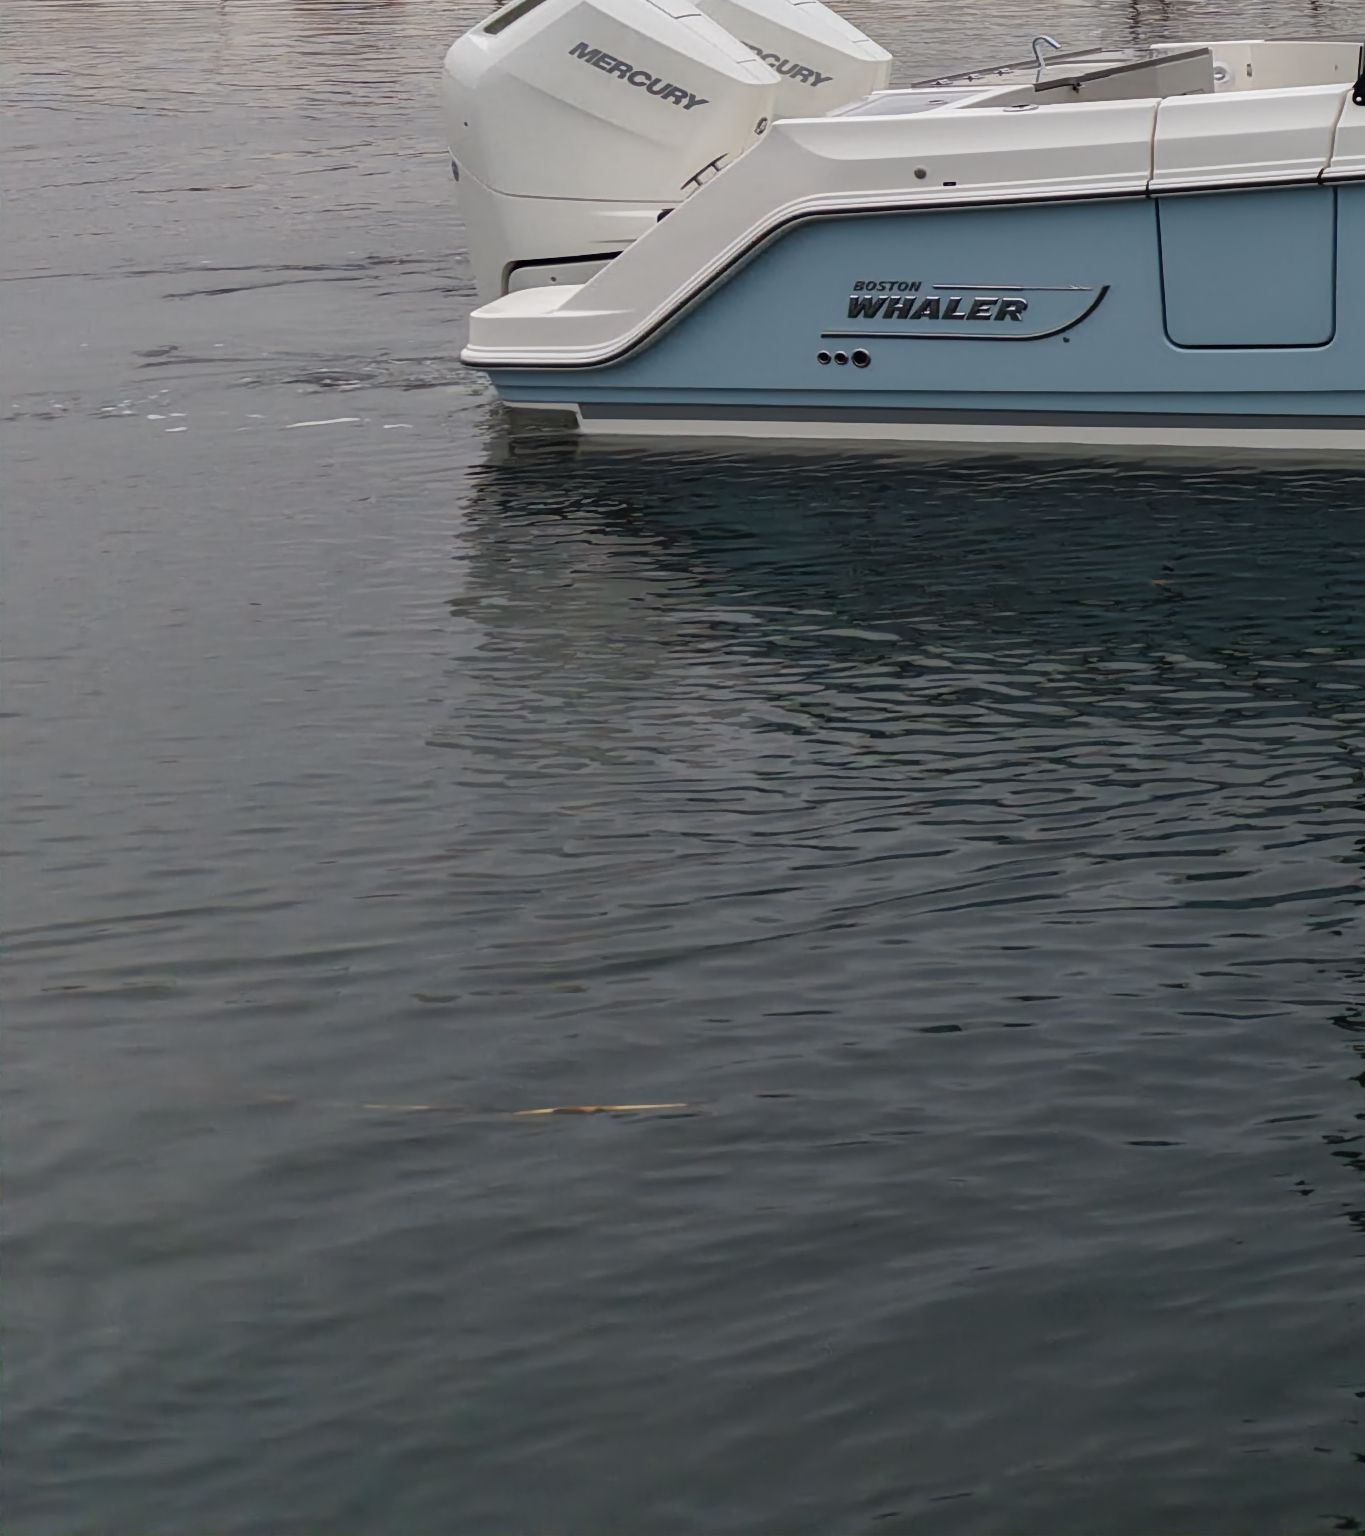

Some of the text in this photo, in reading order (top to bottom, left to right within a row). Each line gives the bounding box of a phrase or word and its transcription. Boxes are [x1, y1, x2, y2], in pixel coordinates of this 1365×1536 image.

[568, 41, 710, 111] MERCURY
[853, 280, 922, 292] BOSTON
[847, 295, 1029, 322] WHALER
